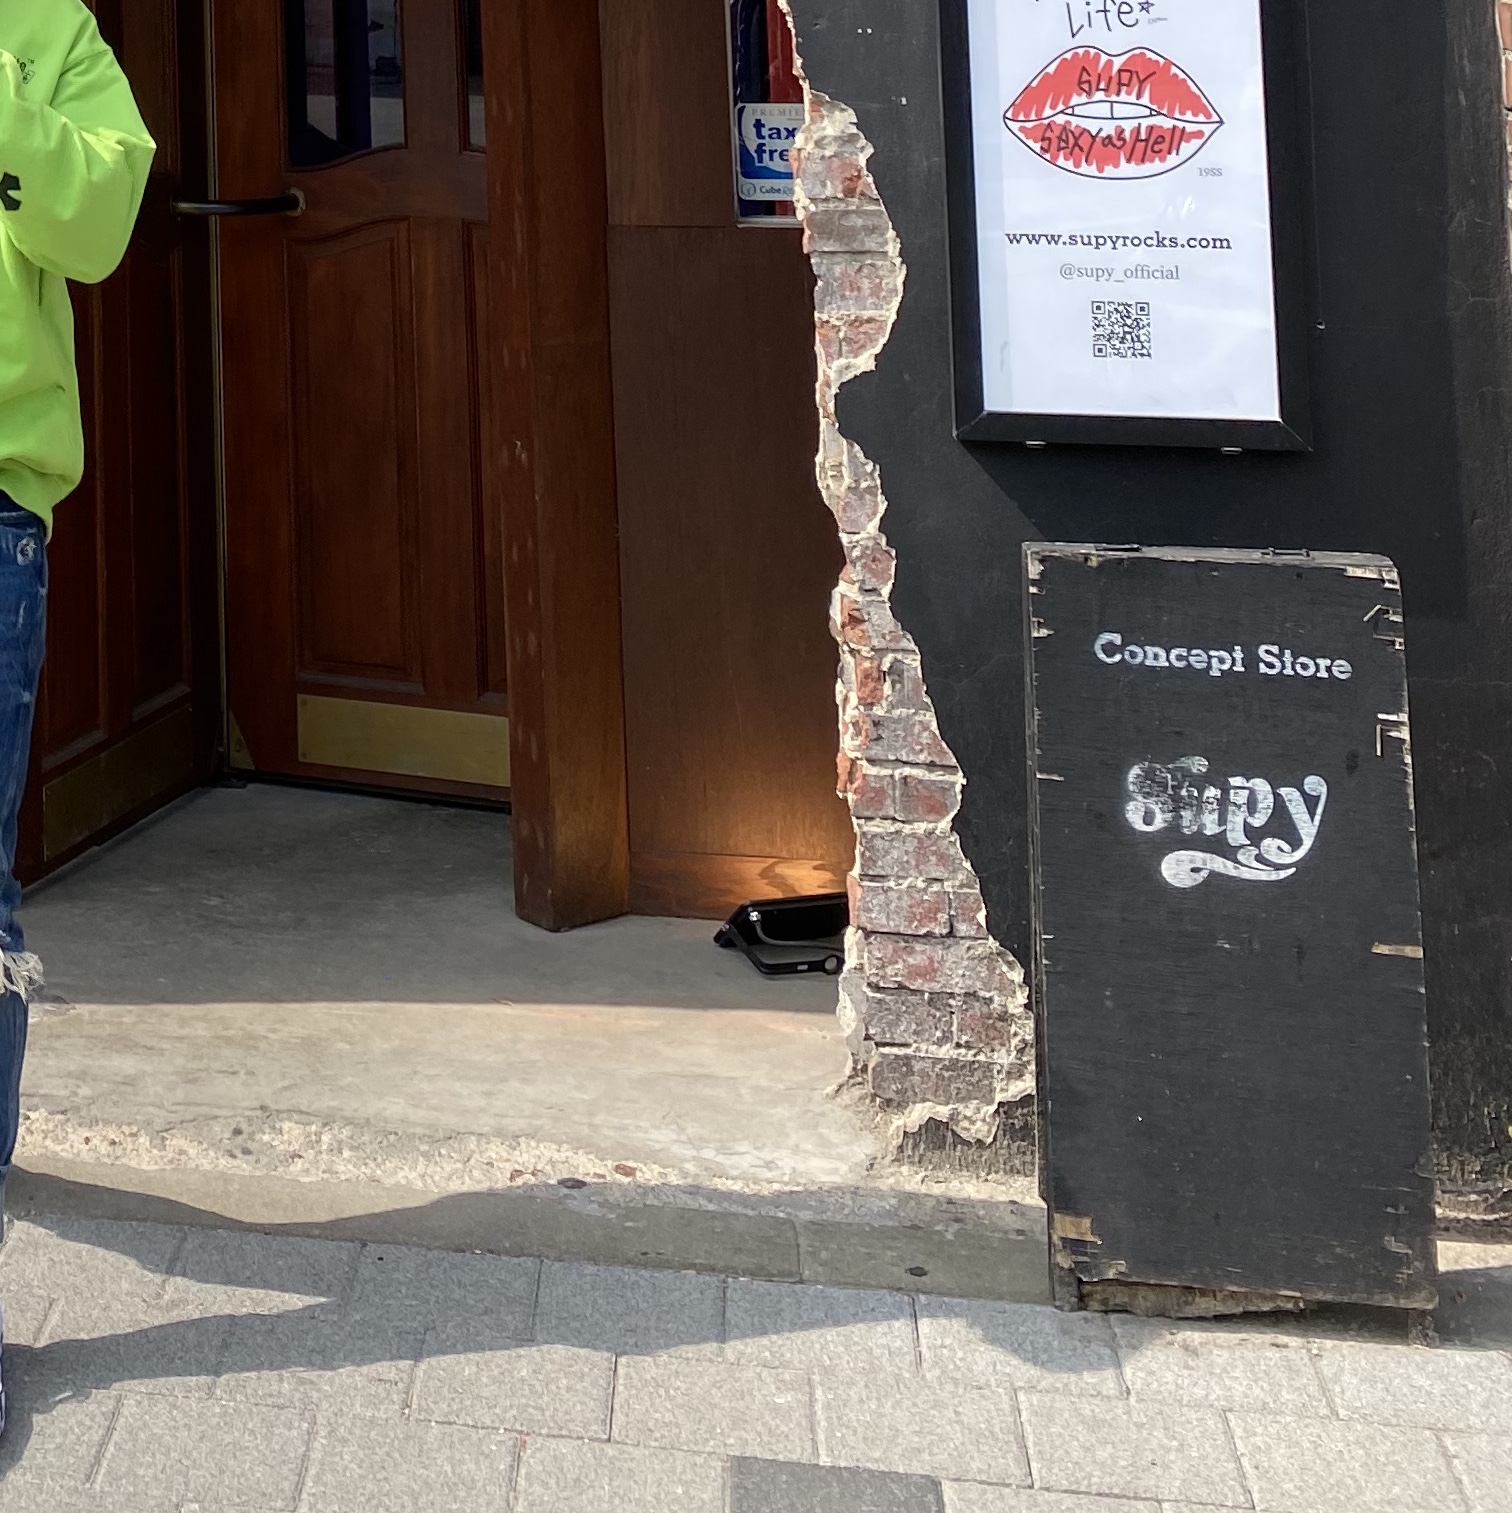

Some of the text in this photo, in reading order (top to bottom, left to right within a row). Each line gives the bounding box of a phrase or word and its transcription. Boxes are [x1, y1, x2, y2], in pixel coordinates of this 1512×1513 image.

[753, 119, 797, 140] tax
[755, 143, 790, 164] fre
[1005, 231, 1232, 250] www.supyrocks.com
[1059, 263, 1180, 283] @supy_official
[1094, 632, 1353, 680] Concept Store
